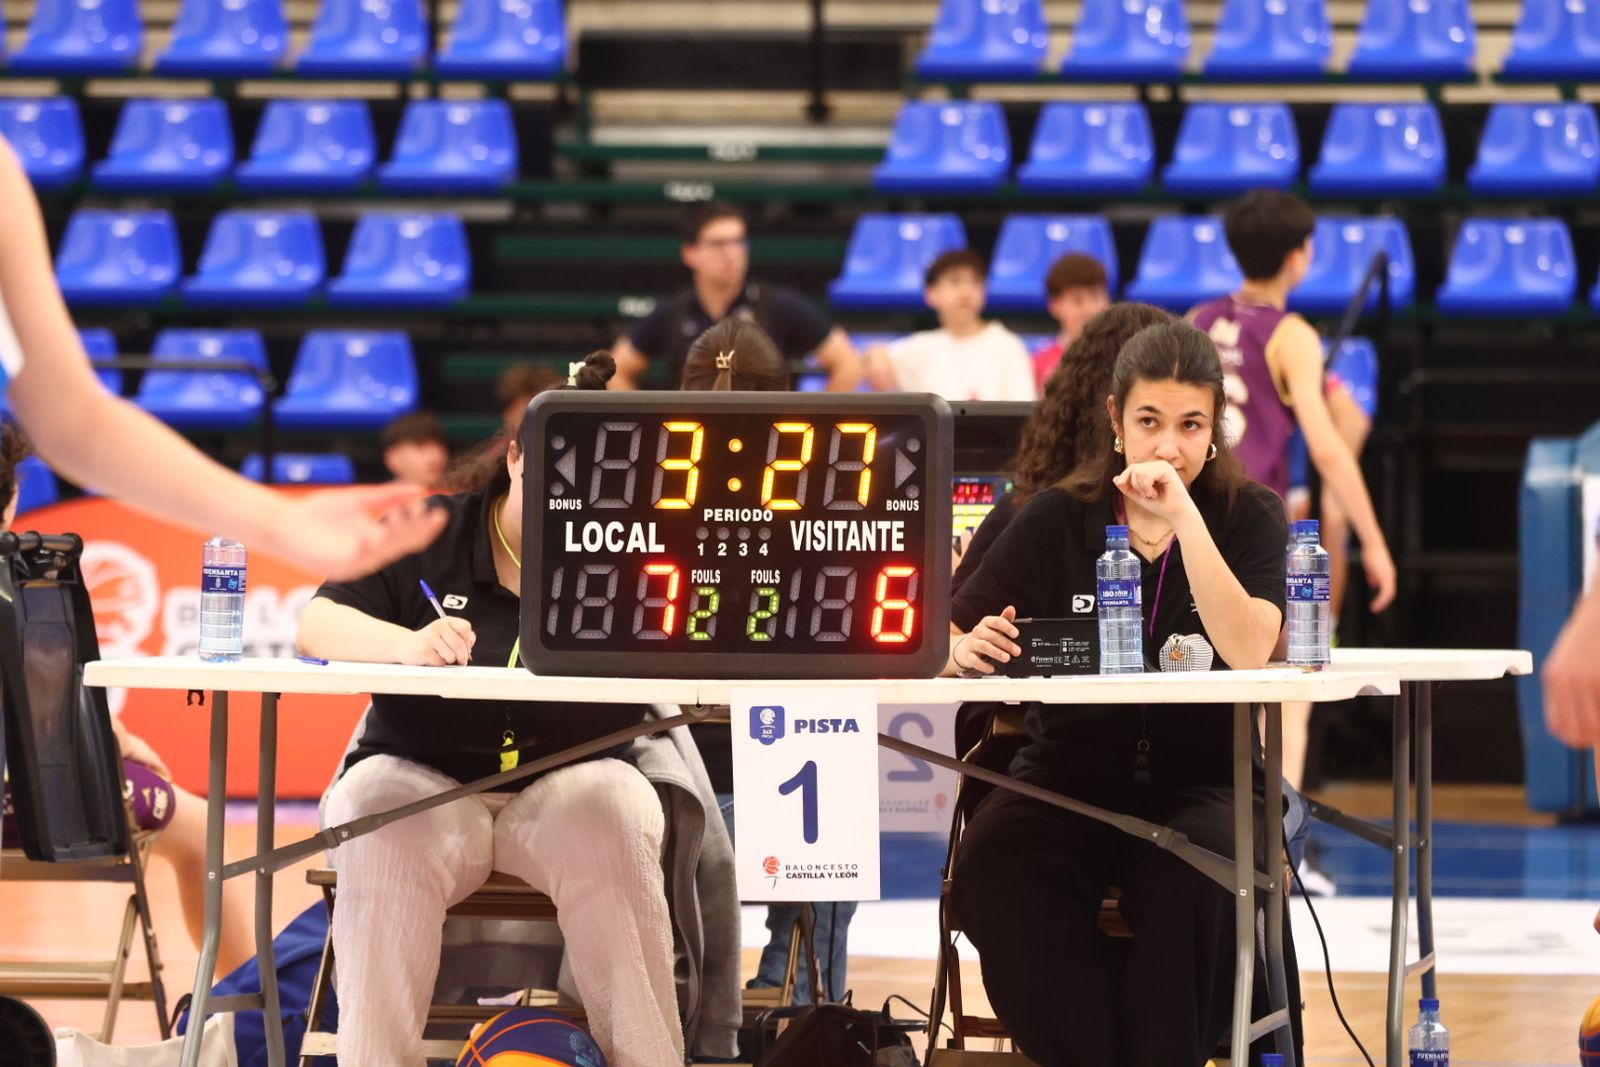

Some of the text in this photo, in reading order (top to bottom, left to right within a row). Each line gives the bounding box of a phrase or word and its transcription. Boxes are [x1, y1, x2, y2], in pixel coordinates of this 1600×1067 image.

[549, 499, 582, 511] BONUS
[886, 499, 920, 512] BONUS
[703, 508, 774, 523] PERIODO
[564, 521, 665, 553] LOCAL
[790, 519, 905, 552] VISITANTE
[697, 543, 769, 557] 1 2 3 4
[691, 569, 721, 584] FOULS
[750, 569, 780, 584] FOULS
[870, 566, 917, 643] 6
[686, 587, 720, 642] 2
[746, 587, 779, 642] 2
[794, 718, 860, 734] PISTA
[778, 760, 819, 845] 1
[785, 863, 858, 871] BALONCESTO
[835, 871, 858, 879] LEÓN
